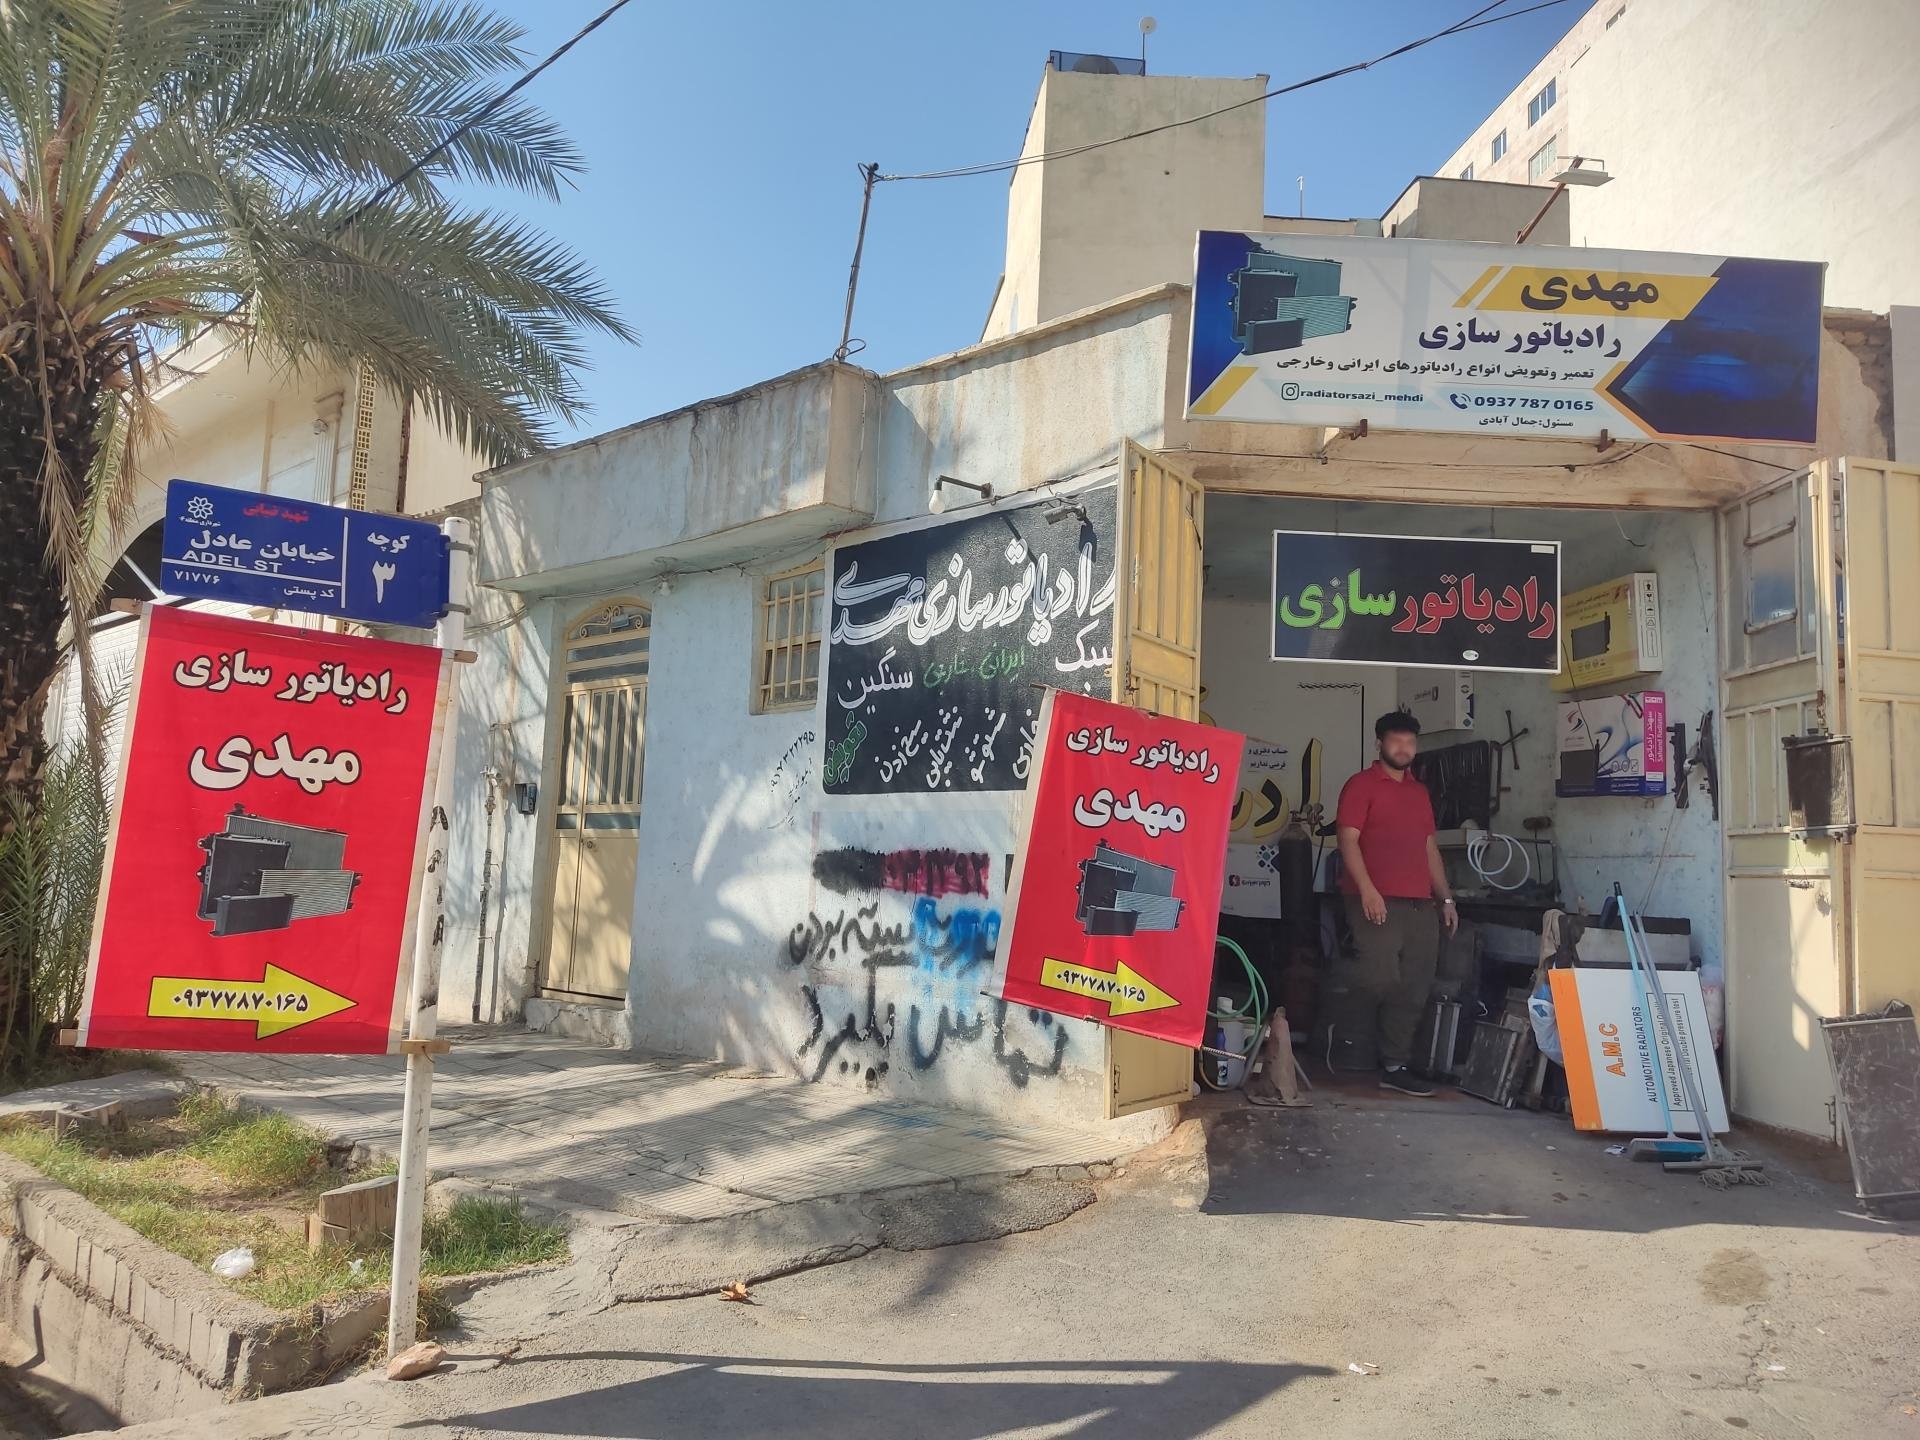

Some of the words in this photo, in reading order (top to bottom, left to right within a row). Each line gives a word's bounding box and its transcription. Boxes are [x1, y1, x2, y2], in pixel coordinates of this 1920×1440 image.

[1520, 273, 1660, 311] مهدی
[1419, 317, 1501, 351] سازی
[1505, 321, 1622, 358] رادیاتور
[1338, 357, 1380, 372] ایرانی
[1466, 363, 1501, 378] انواع
[1560, 368, 1594, 381] تعمیر
[1300, 388, 1424, 402] radiatorsazi_mehdi
[1474, 396, 1517, 408] 0937
[1521, 398, 1550, 409] 787
[1553, 399, 1594, 411] 0165
[1479, 415, 1509, 426] آبادی
[190, 530, 252, 550] عادل
[259, 541, 335, 564] خیابان
[366, 530, 410, 553] کوچه
[182, 549, 247, 569] ADEL
[253, 559, 283, 574] ST
[174, 570, 220, 585] ۷۱۷۷۶
[283, 586, 317, 600] پستی
[320, 588, 334, 598] کد
[372, 560, 396, 604] ۳
[1279, 568, 1397, 630] سازی
[1391, 573, 1555, 639] رادیاتور
[174, 648, 271, 691] سازی
[837, 645, 914, 714] سنگین
[276, 661, 409, 714] رادیاتور
[1066, 725, 1128, 755] سازی
[188, 733, 361, 795] مهدی
[1131, 739, 1220, 783] رادیاتور
[1073, 788, 1187, 837] مهدی
[173, 987, 309, 1012] ۰۹۳۷۷۸۷۰۱۶۵
[1056, 968, 1146, 1003] ۰۹۳۷۷۸۷۰۱۶۵
[1632, 1005, 1648, 1050] RADIATORS
[1675, 1010, 1687, 1036] pressure
[1599, 1022, 1626, 1077] A.M.C
[1664, 1046, 1676, 1075] Japanese
[1639, 1051, 1658, 1103] AUTOMOTIVE
[1671, 1074, 1681, 1107] Approved
